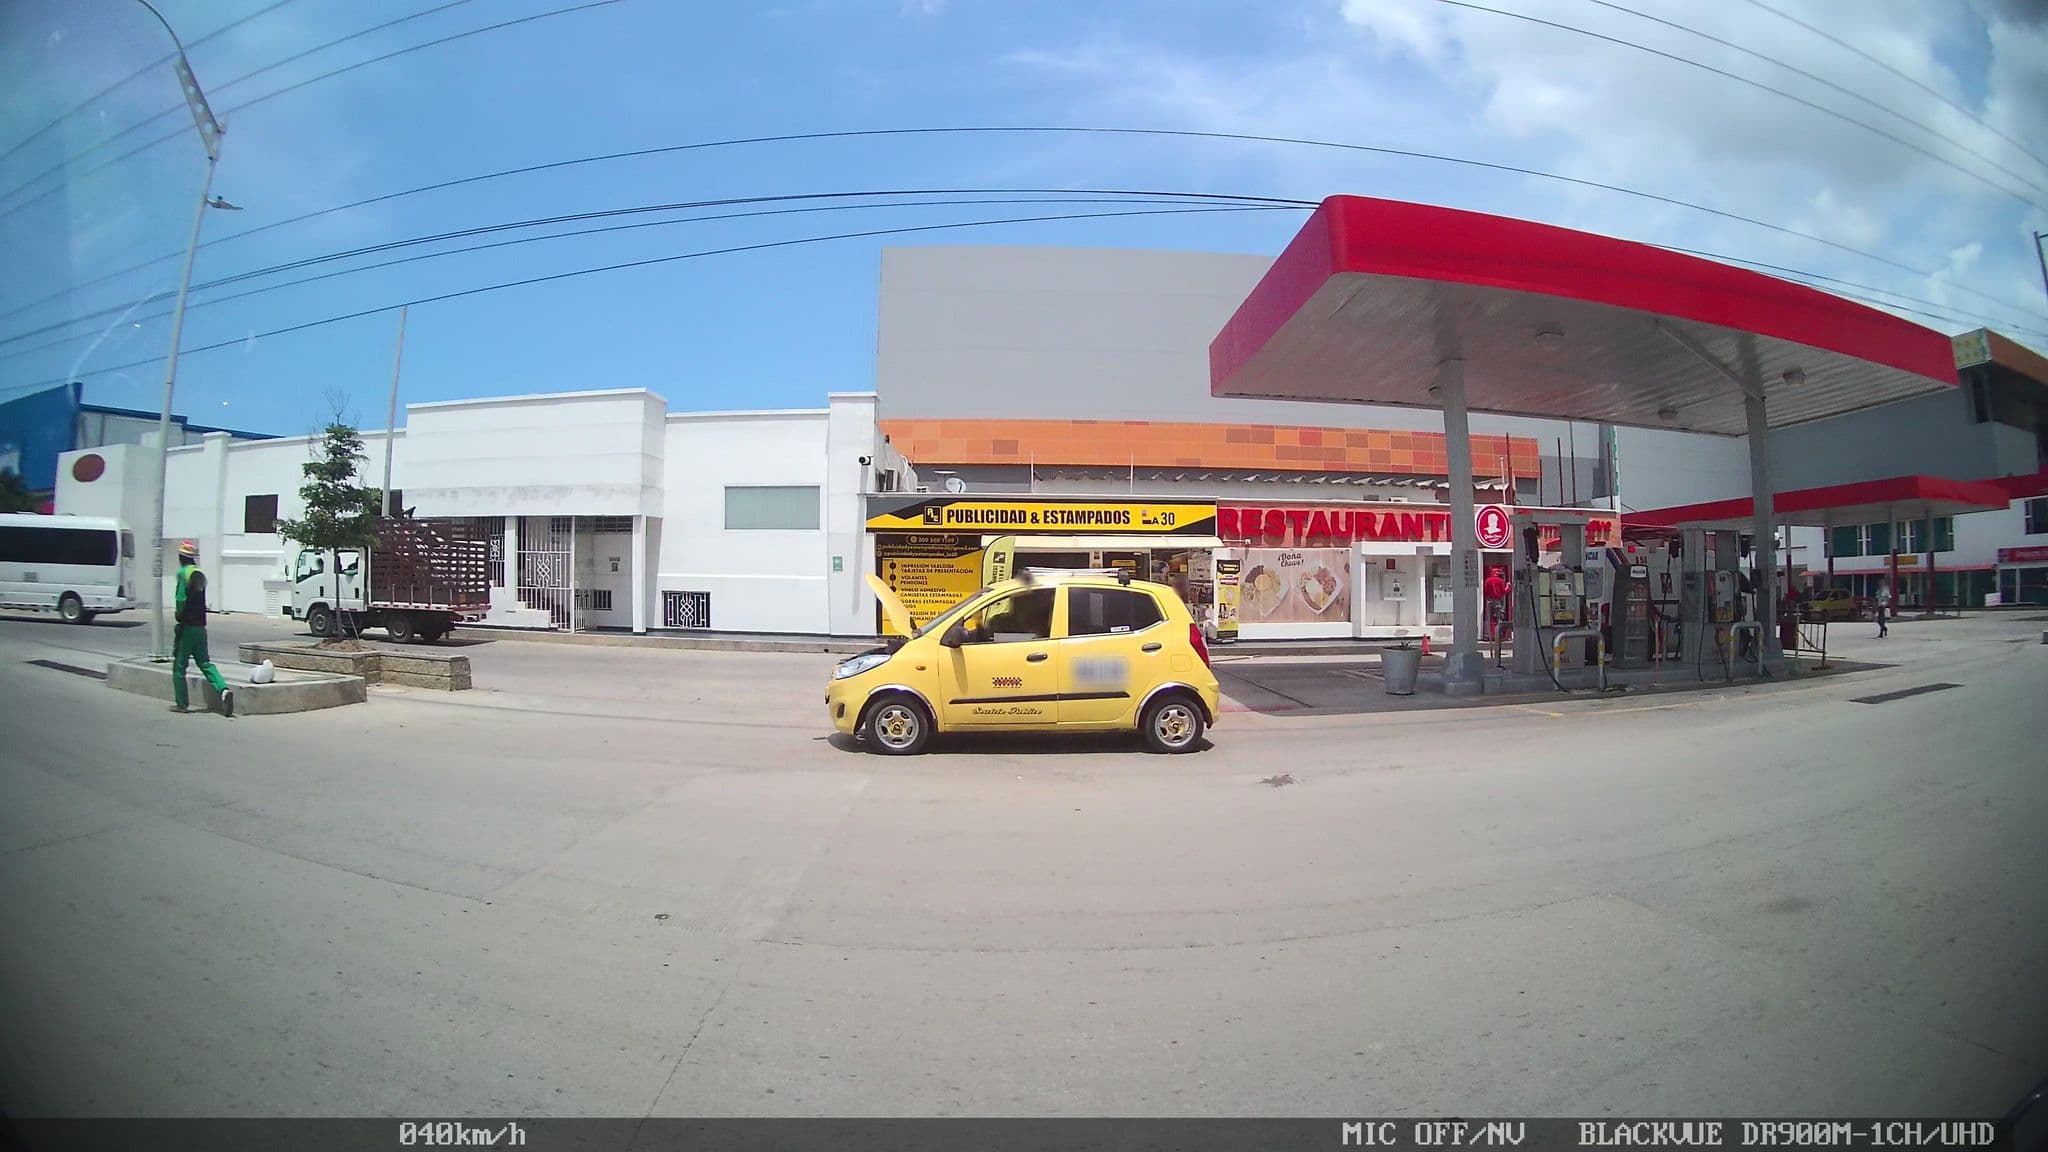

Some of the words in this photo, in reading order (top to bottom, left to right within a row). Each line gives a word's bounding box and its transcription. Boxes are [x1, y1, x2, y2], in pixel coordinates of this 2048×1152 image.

[946, 509, 1027, 524] PUBLICIDAD
[1030, 511, 1040, 524] &
[1043, 510, 1131, 525] ESTAMPADOS
[1160, 512, 1175, 526] 30
[1217, 508, 1452, 539] RESTAURANT
